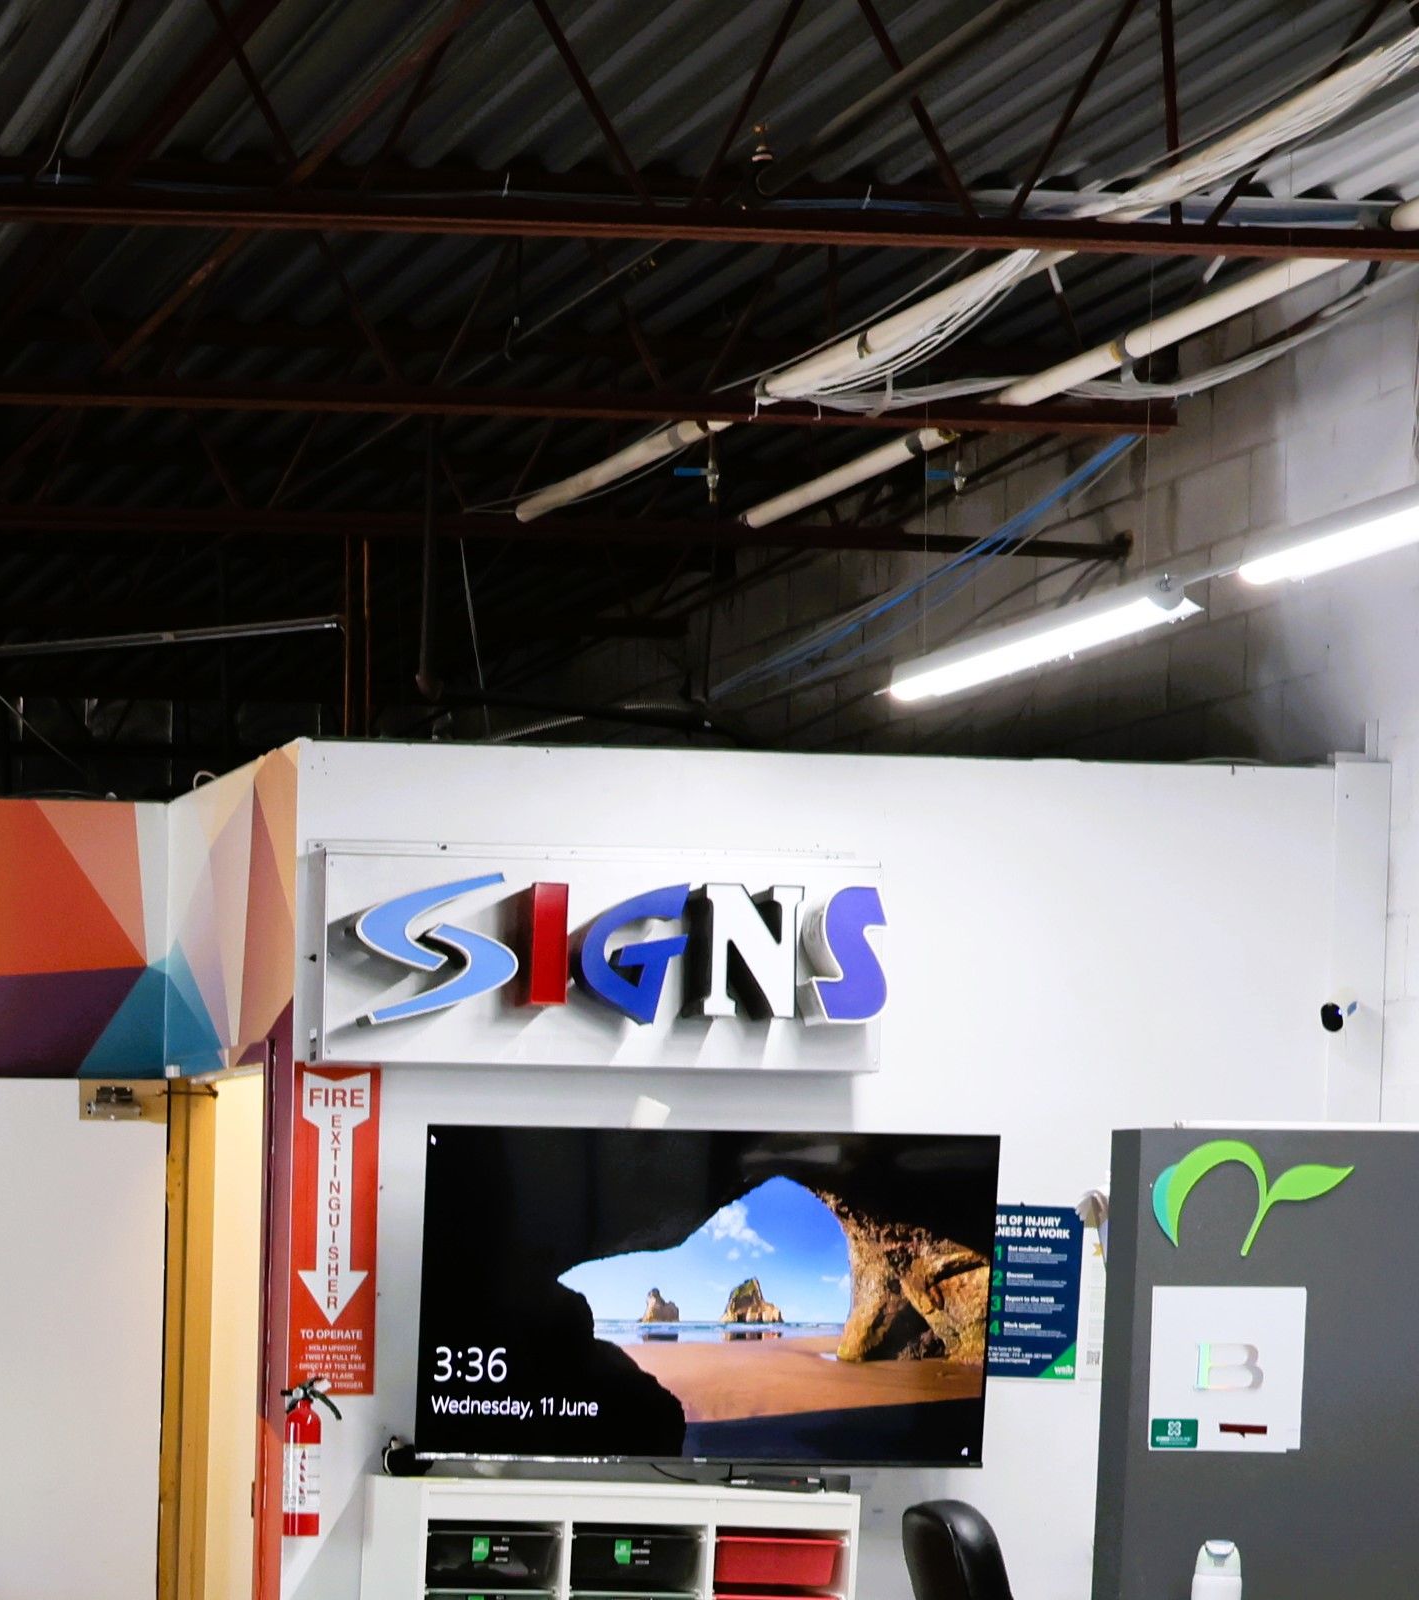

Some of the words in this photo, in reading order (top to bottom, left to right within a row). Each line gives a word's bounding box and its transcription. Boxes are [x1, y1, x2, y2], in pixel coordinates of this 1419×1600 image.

[356, 873, 890, 1025] SIGNS
[309, 1088, 364, 1107] FIRE
[327, 1114, 341, 1309] EXTINGUISHER
[1009, 1215, 1023, 1225] OF
[1025, 1216, 1061, 1227] INJURY
[1024, 1227, 1037, 1238] AT
[1038, 1228, 1070, 1239] WORK
[995, 1245, 1002, 1261] 1
[992, 1270, 1003, 1287] 2
[990, 1295, 1001, 1312] 3
[300, 1329, 314, 1339] TO
[316, 1329, 363, 1340] OPERATE
[989, 1320, 1001, 1336] 4
[433, 1346, 507, 1382] 3:36
[1194, 1342, 1263, 1391] B
[431, 1395, 533, 1420] Wednesday,
[540, 1397, 554, 1415] 11
[559, 1397, 598, 1416] June
